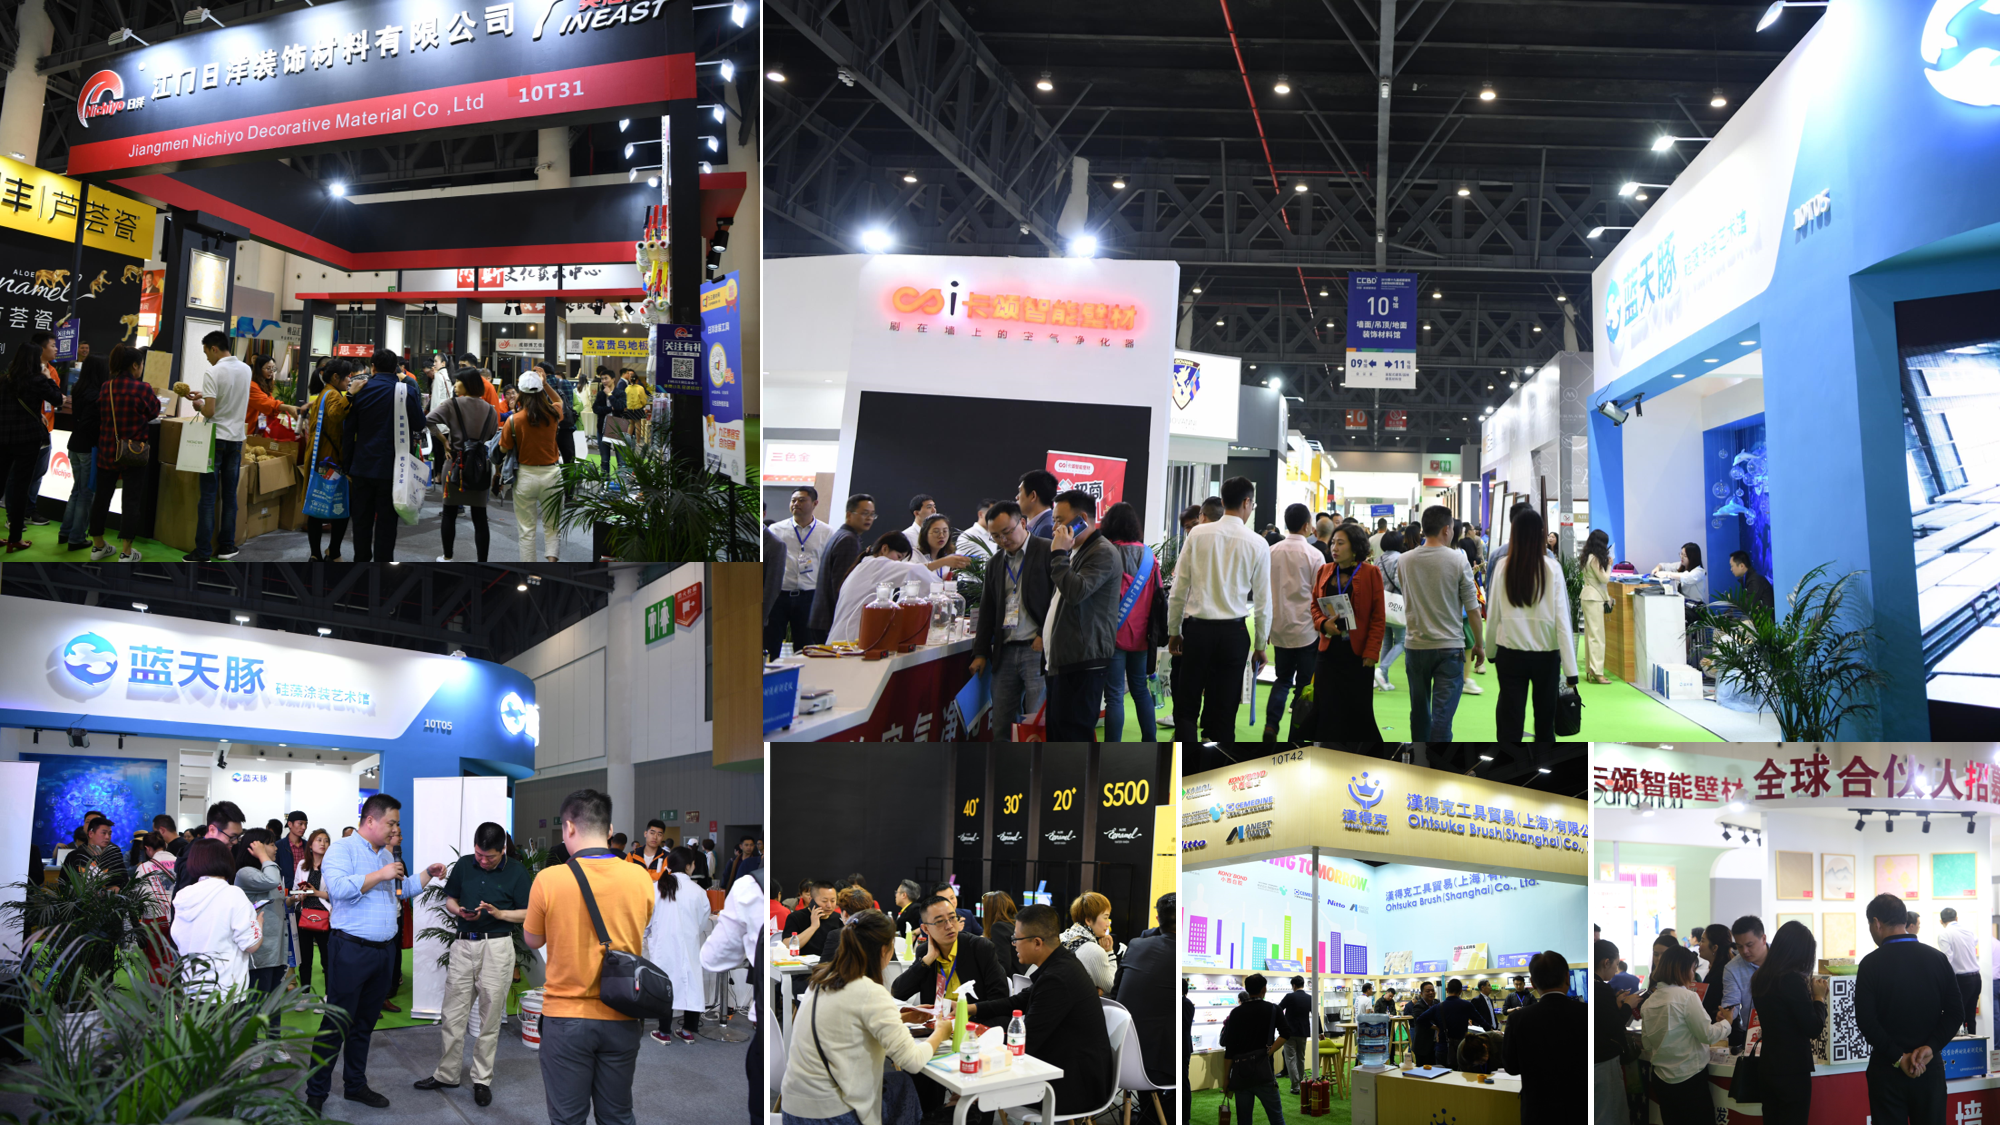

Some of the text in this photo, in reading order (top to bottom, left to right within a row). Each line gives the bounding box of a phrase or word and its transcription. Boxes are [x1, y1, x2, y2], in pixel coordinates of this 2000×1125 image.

[150, 2, 515, 101] 江门日洋装饰材料有限公司
[519, 80, 584, 103] 10T31
[85, 100, 126, 118] Nichiyo
[127, 96, 146, 111] 日洋
[128, 139, 189, 158] Jiangmen
[192, 130, 244, 148] Nichiyo
[247, 118, 331, 139] Decorative
[335, 104, 407, 129] Material
[1793, 188, 1832, 231] 10T05
[13, 268, 35, 278] ALOE
[1622, 229, 1678, 328] 蓝天豚
[961, 291, 1138, 332] 卡颂智能壁材
[1367, 296, 1389, 316] 10
[0, 306, 53, 331] 荟瓷
[1356, 320, 1408, 329] 墙面/吊顶/地面
[889, 321, 1135, 349] 刷在墙上的空气净化器
[1362, 330, 1401, 339] 装饰材料馆
[595, 339, 650, 351] 富贵鸟地板
[664, 341, 701, 352] 关注有礼
[1350, 359, 1363, 368] 09
[1394, 360, 1405, 369] 11
[770, 452, 811, 462] 三色金
[53, 467, 71, 479] Nichiyo
[128, 644, 266, 695] 蓝天豚
[275, 682, 371, 706] 硅藻涂装艺术馆
[425, 719, 453, 731] 10T05
[1272, 750, 1304, 766] 10T42
[242, 773, 268, 783] 蓝天豚
[1102, 779, 1149, 808] S500
[1235, 796, 1273, 810] CEMEDINE
[1342, 808, 1388, 826] 漢得克
[1408, 813, 1466, 834] Ohtsuka
[1244, 820, 1273, 832] ANEST
[1246, 828, 1271, 839] IWATA
[1217, 870, 1248, 882] KONY BOND
[1299, 856, 1368, 892] TOMORROW
[1327, 899, 1346, 909] Nitto
[1385, 899, 1418, 912] Ohtsuka
